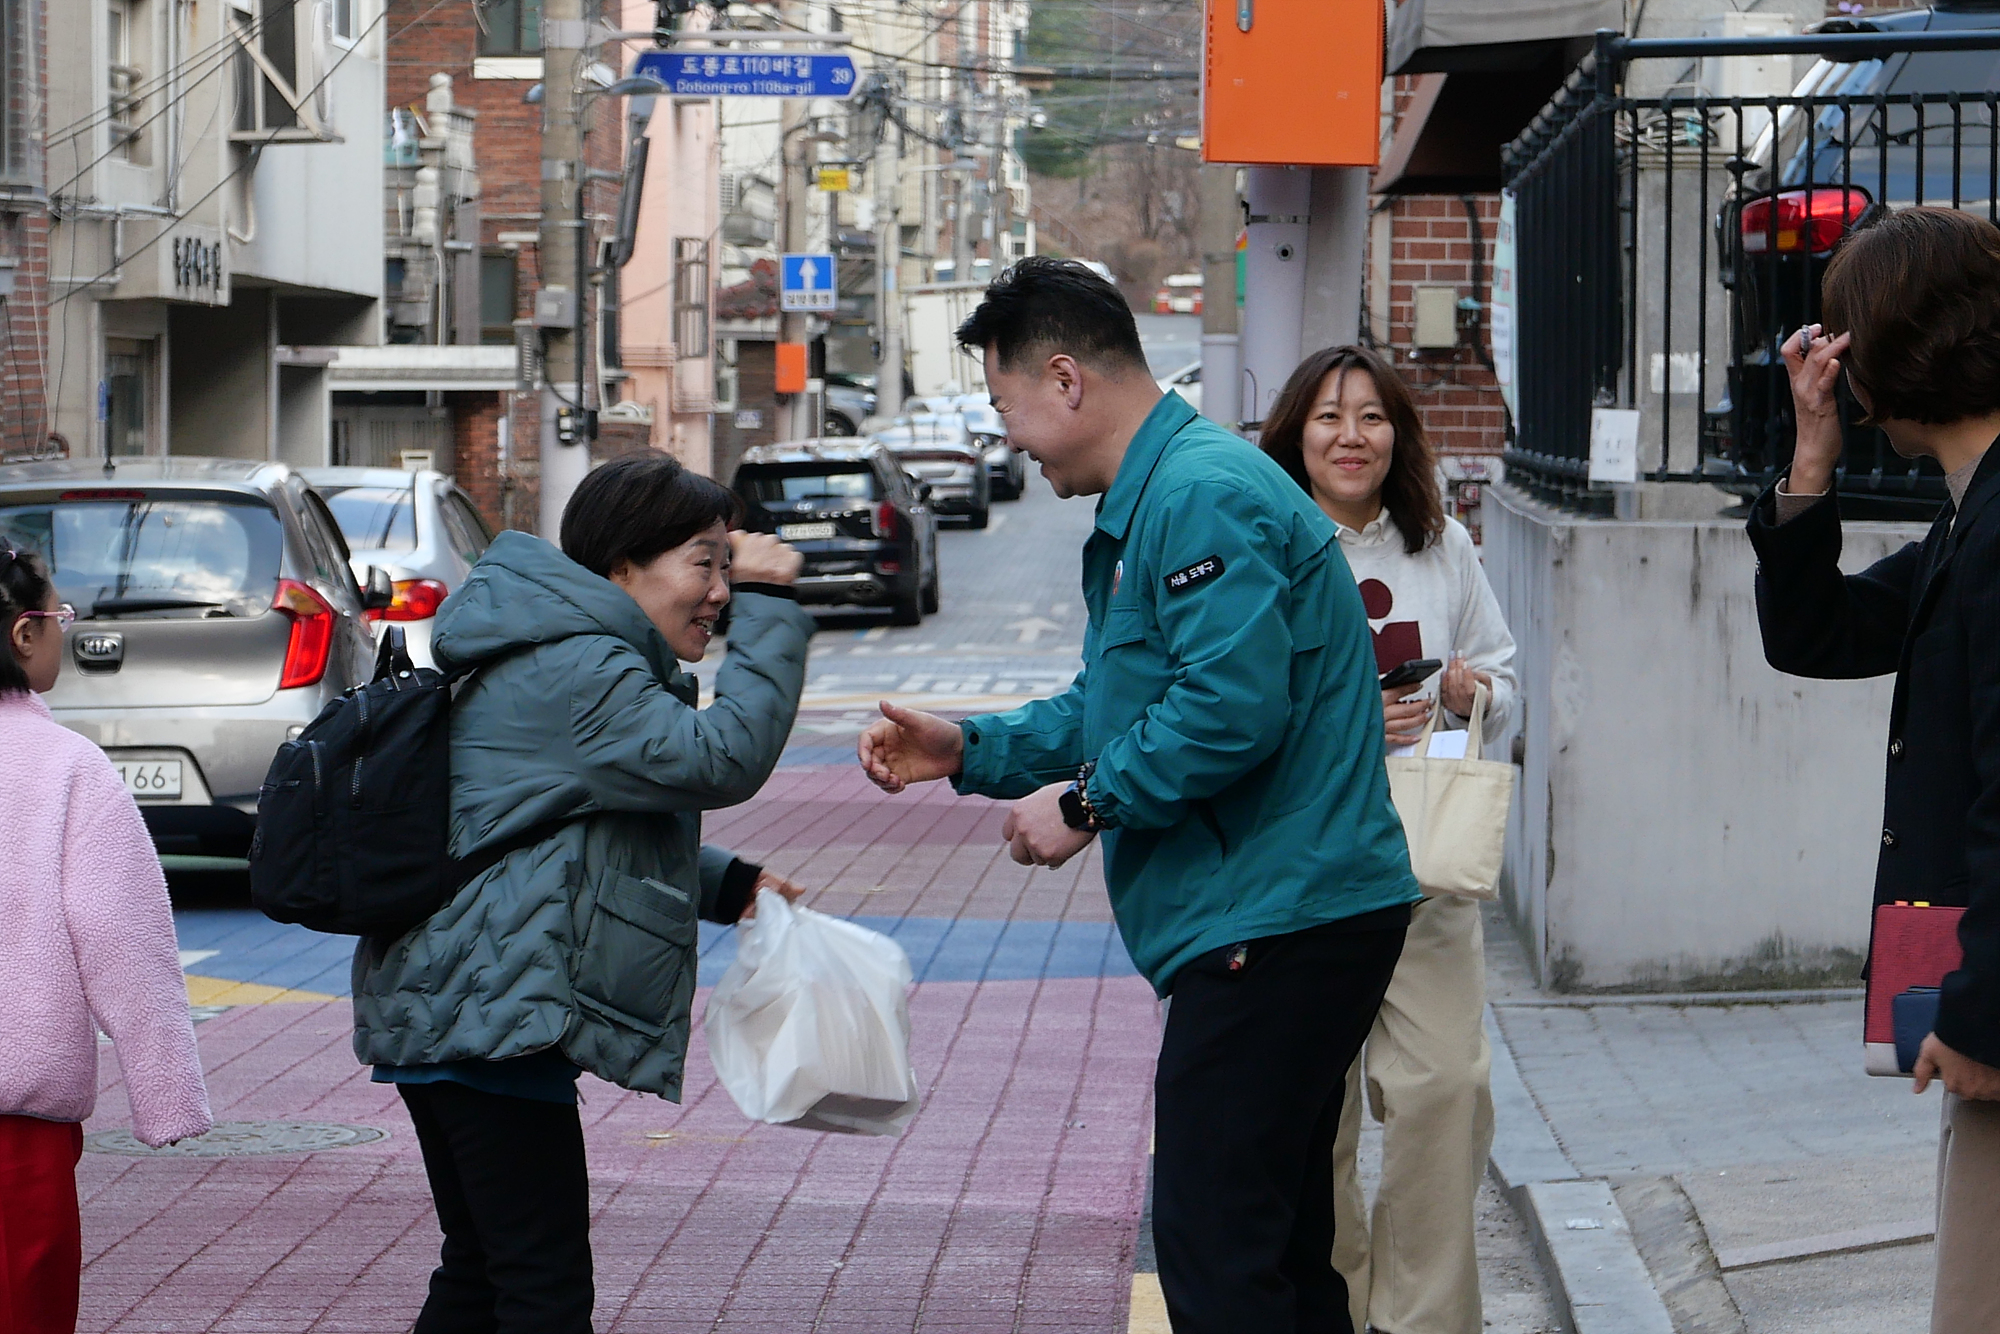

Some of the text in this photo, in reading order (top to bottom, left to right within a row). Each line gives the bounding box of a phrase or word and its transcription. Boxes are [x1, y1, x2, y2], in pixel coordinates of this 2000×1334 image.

[680, 56, 813, 78] 도봉로110바길
[831, 67, 850, 85] 39
[676, 80, 814, 95] Dobong-ro 110ba-gil
[1171, 560, 1215, 588] 서울 도봉구
[83, 638, 115, 655] KIA
